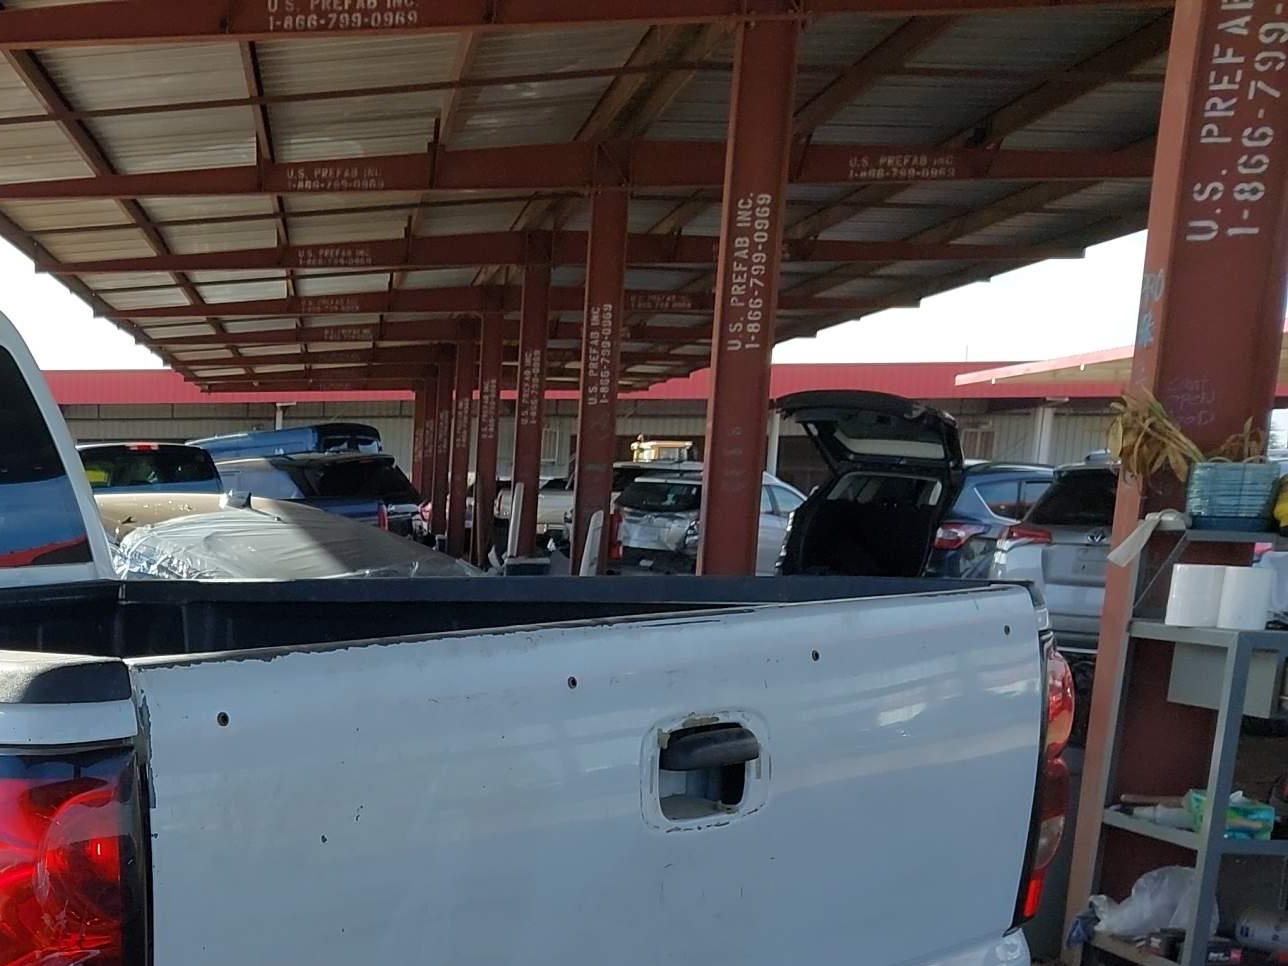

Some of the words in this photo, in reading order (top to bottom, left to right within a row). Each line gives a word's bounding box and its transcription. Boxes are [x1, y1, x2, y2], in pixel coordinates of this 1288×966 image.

[269, 11, 418, 31] 1-866-799-0969
[736, 192, 754, 228] INC.
[1186, 169, 1228, 241] U.S.
[730, 236, 750, 307] PREFAB
[745, 193, 773, 350] 1-866-799-0969
[727, 316, 746, 351] U.S.
